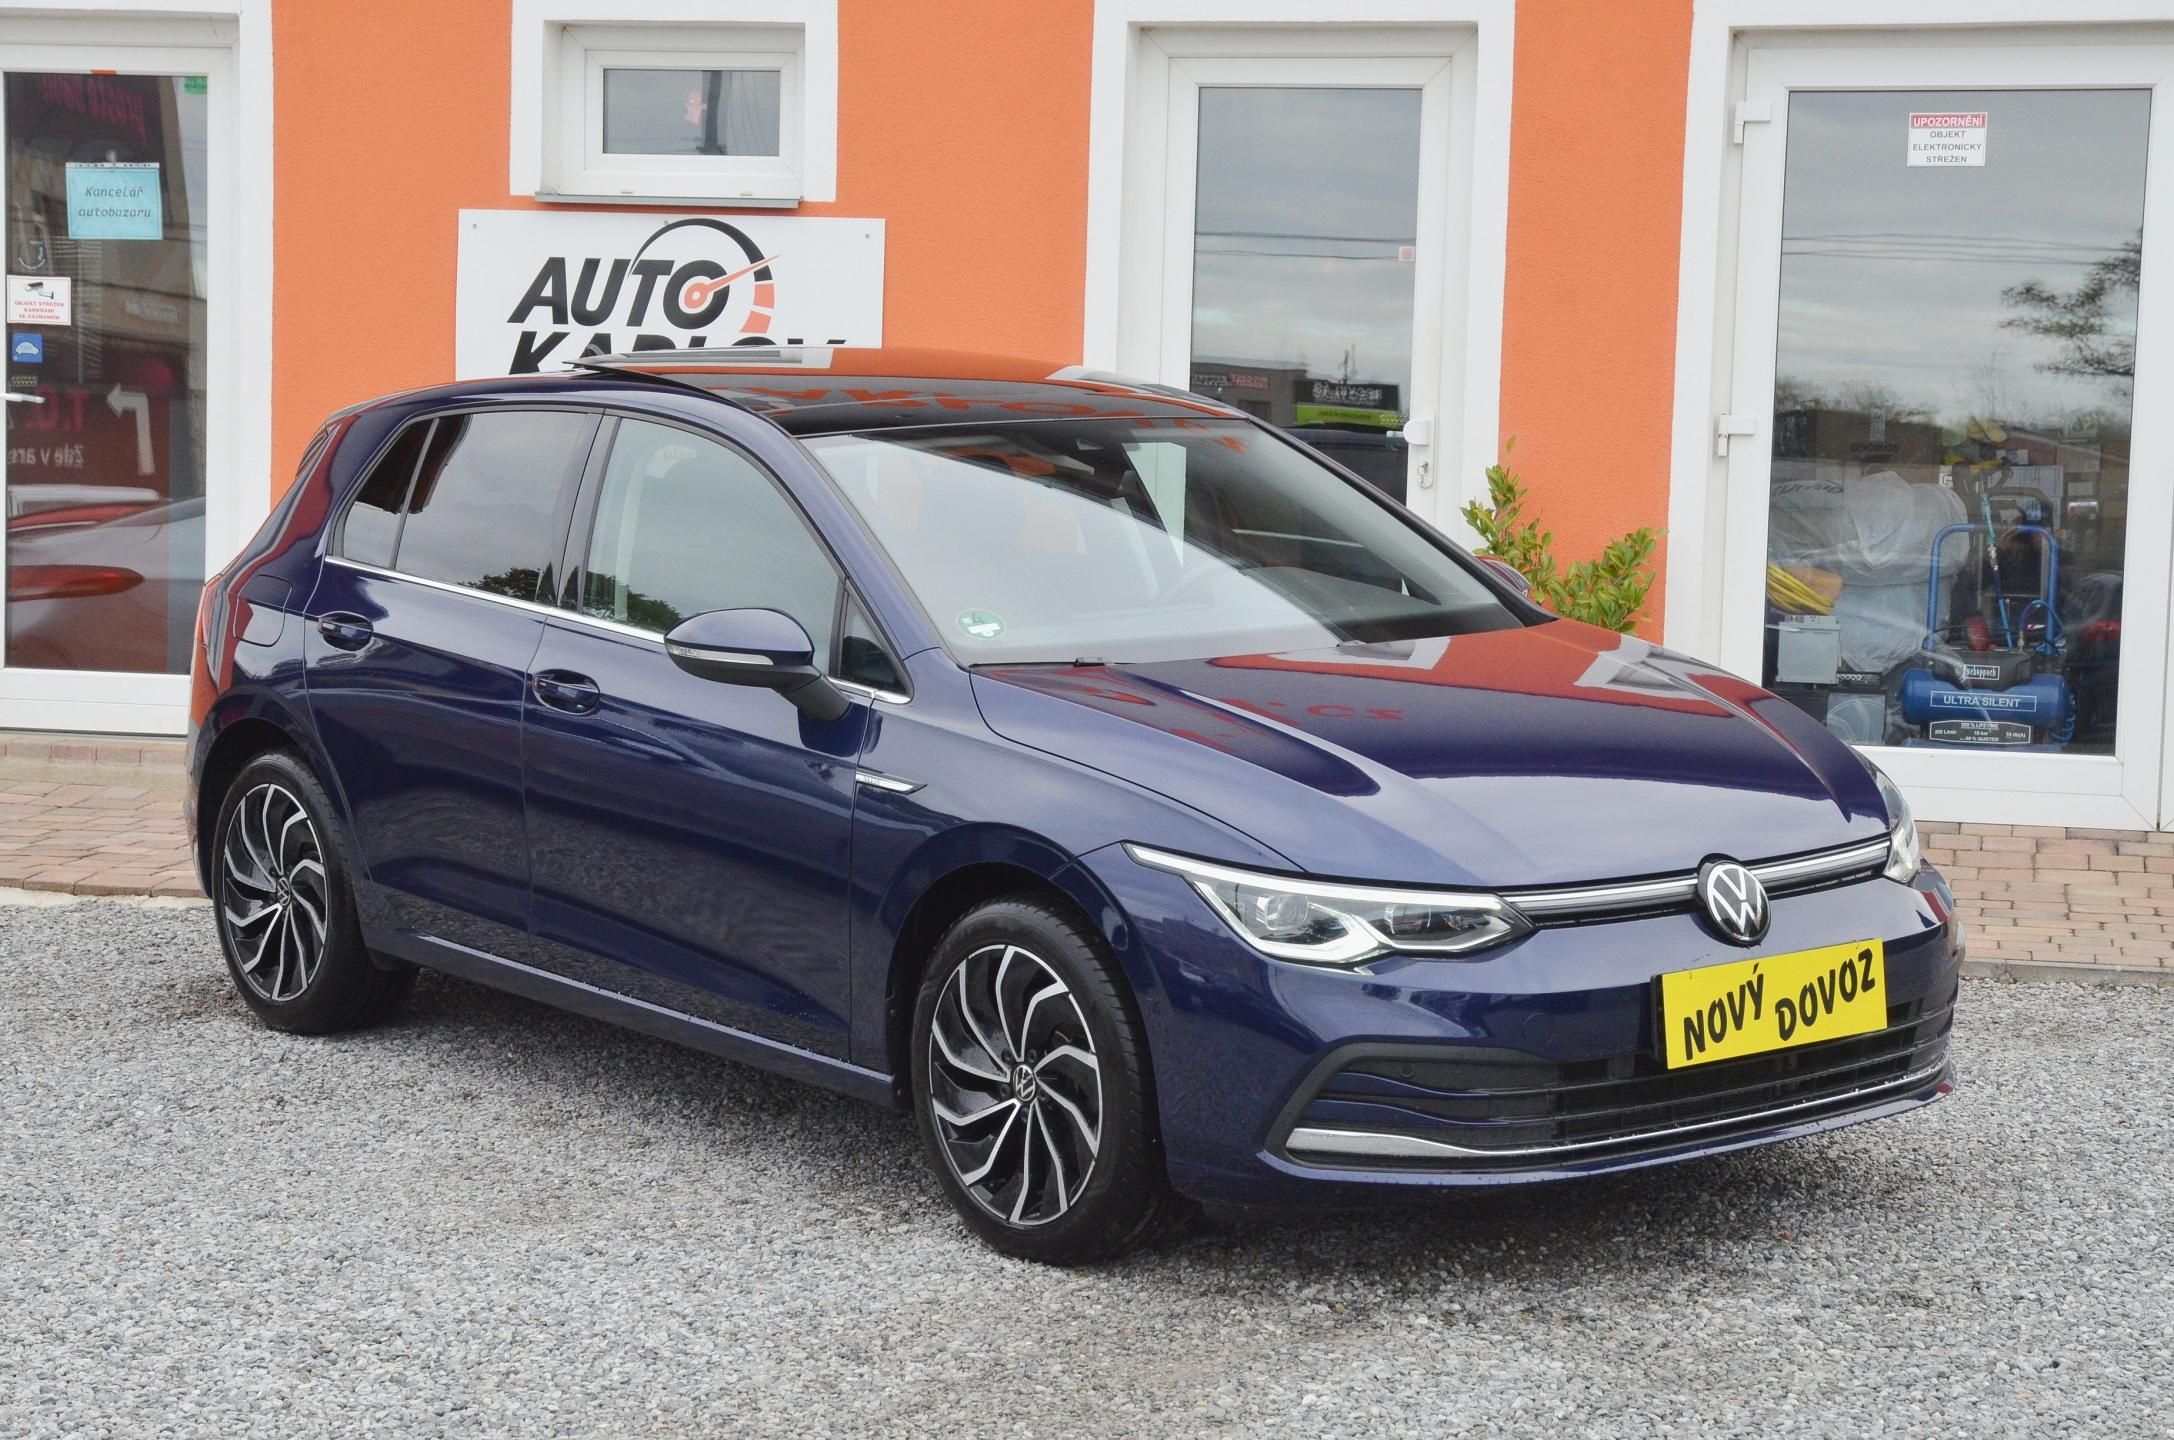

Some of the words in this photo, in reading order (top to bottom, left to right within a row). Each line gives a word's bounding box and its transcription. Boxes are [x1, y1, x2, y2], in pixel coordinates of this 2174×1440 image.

[1929, 130, 1967, 138] OBJEKT
[1912, 143, 1982, 151] ELEKTRONICKY
[1926, 154, 1967, 163] STŘEŽEN
[78, 207, 151, 218] autobazaru
[507, 256, 730, 330] AUTO
[1943, 694, 1980, 706] ULTRA
[1982, 697, 2021, 709] SILENT
[1683, 962, 1765, 1061] NOVÝ
[1775, 948, 1876, 1041] DOVOZ
